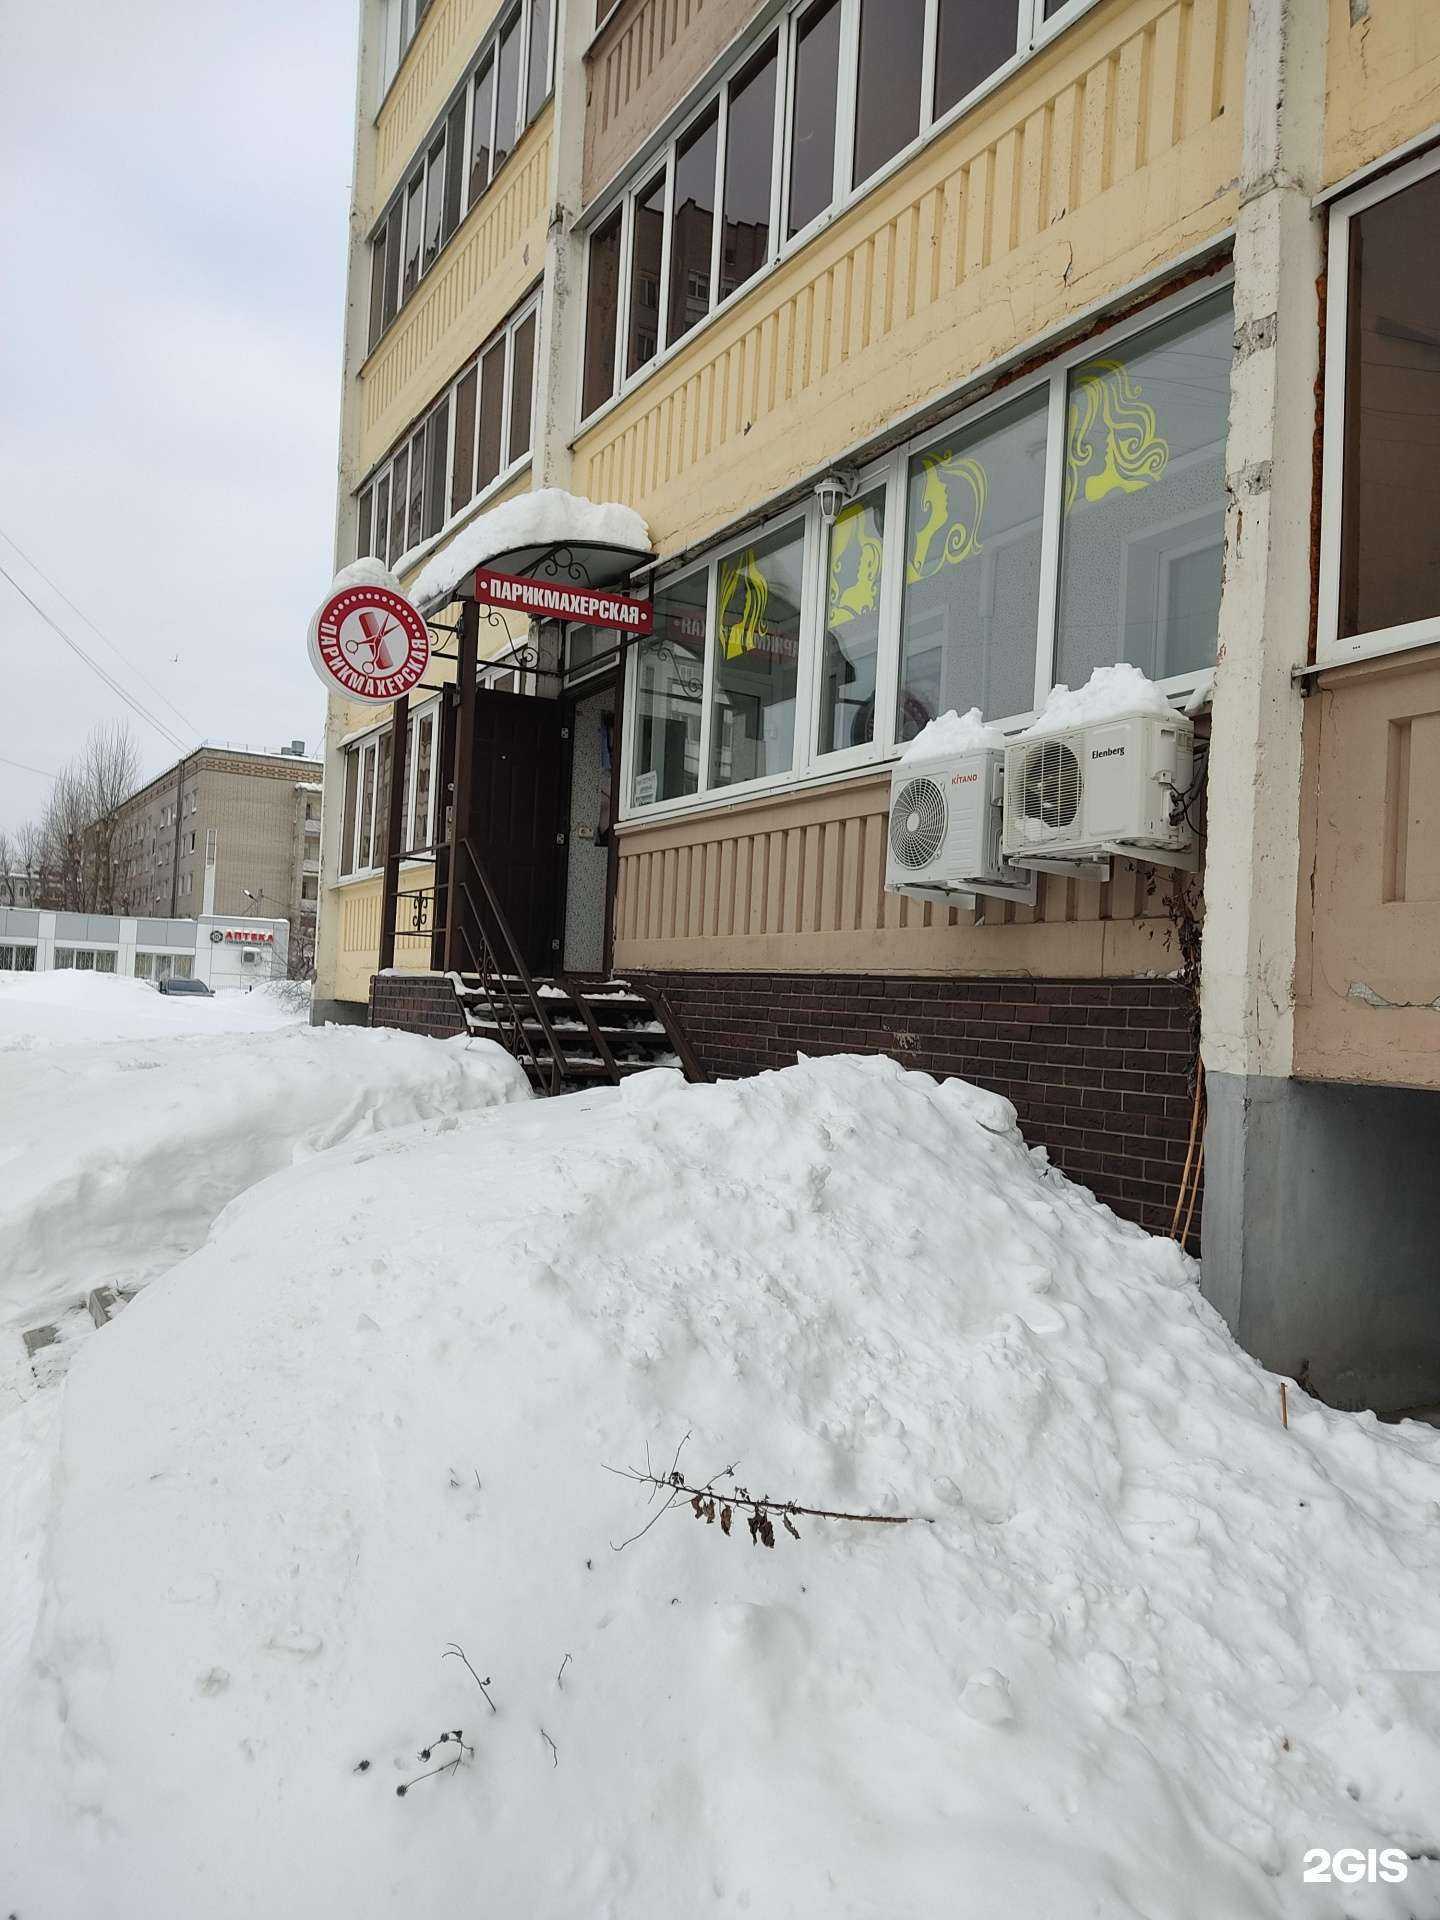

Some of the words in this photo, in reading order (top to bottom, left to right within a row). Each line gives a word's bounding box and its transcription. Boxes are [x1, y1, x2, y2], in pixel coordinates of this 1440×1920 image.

[490, 578, 640, 625] ПАРИКМАХЕРСКАЯ
[320, 622, 427, 696] ПАРИКМАХЕРСКАЯ
[1092, 746, 1125, 759] Elenberg
[225, 931, 274, 942] АПТЕКА
